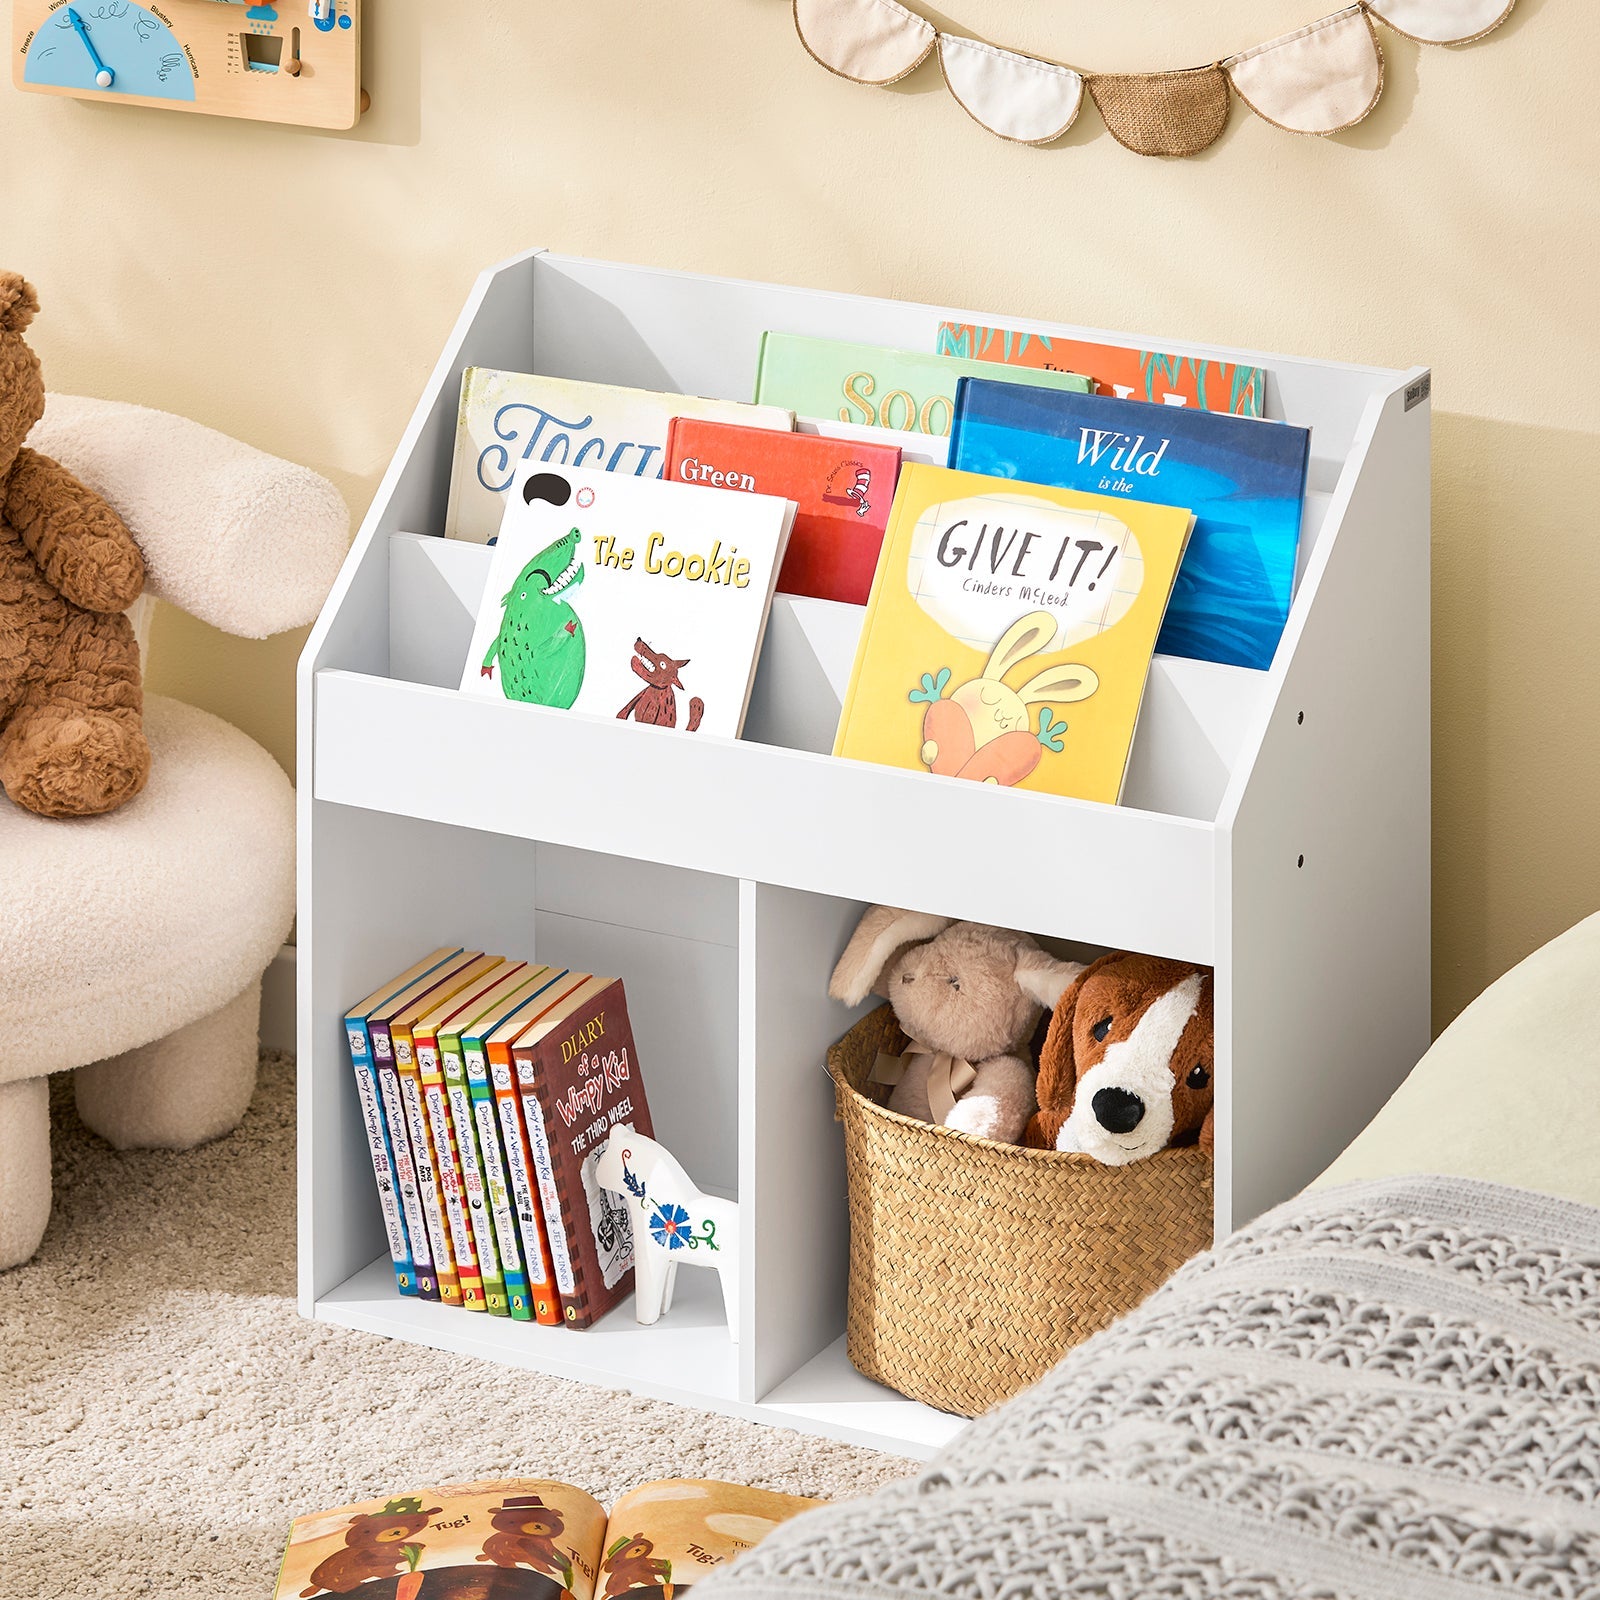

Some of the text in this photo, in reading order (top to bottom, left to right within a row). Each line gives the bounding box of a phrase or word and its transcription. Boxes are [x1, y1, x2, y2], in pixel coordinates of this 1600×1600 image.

[150, 4, 174, 29] Blustery
[20, 30, 35, 55] Breeze
[183, 43, 200, 79] Hurricane
[1077, 427, 1170, 476] Wild
[679, 457, 756, 493] Green
[1098, 475, 1134, 493] is the
[593, 531, 750, 588] The Cookie
[937, 520, 1118, 591] GIVE IT!
[962, 578, 1013, 597] Cinders
[560, 1012, 605, 1064] DIARY
[578, 1053, 600, 1076] of a
[359, 1069, 371, 1093] Diary
[383, 1072, 395, 1096] Diary
[556, 1047, 630, 1128] Wimpy Kid
[429, 1093, 440, 1115] Diary
[453, 1091, 464, 1114] Diary
[527, 1098, 539, 1123] Diary
[368, 1108, 378, 1135] Wimpy
[392, 1111, 402, 1138] Wimpy
[405, 1079, 416, 1103] Diary
[413, 1118, 422, 1145] Wimpy
[418, 1147, 427, 1160] Kid
[479, 1106, 489, 1127] Diary
[571, 1096, 634, 1155] THE THIRD WHEEL
[372, 1136, 382, 1149] Kid
[396, 1140, 406, 1153] Kid
[437, 1130, 447, 1154] Wimpy
[461, 1129, 470, 1154] Wimpy
[487, 1141, 495, 1164] Wimpy
[502, 1102, 514, 1125] Diary
[511, 1141, 519, 1168] Wimpy
[515, 1169, 524, 1182] Kid
[536, 1139, 545, 1166] Wimpy
[398, 1159, 406, 1180] TRUTH
[419, 1165, 427, 1182] DAYS
[441, 1156, 450, 1168] Kid
[465, 1156, 474, 1168] Kid
[490, 1165, 499, 1177] Kid
[540, 1167, 550, 1180] Kid
[523, 1196, 531, 1211] LONG
[385, 1197, 402, 1256] JEFF KINNEY
[409, 1201, 425, 1260] JEFF KINNEY
[430, 1208, 445, 1267] JEFF KINNEY
[452, 1207, 468, 1262] JEFF KINNEY
[476, 1215, 491, 1271] JEFF KINNEY
[501, 1216, 514, 1268] JEFF KINNEY
[525, 1223, 541, 1280] JEFF KINNEY
[553, 1229, 569, 1288] JEFF KINNEY
[429, 1515, 472, 1531] Tug!
[566, 1546, 595, 1581] Tug!
[686, 1543, 725, 1565] Tug!
